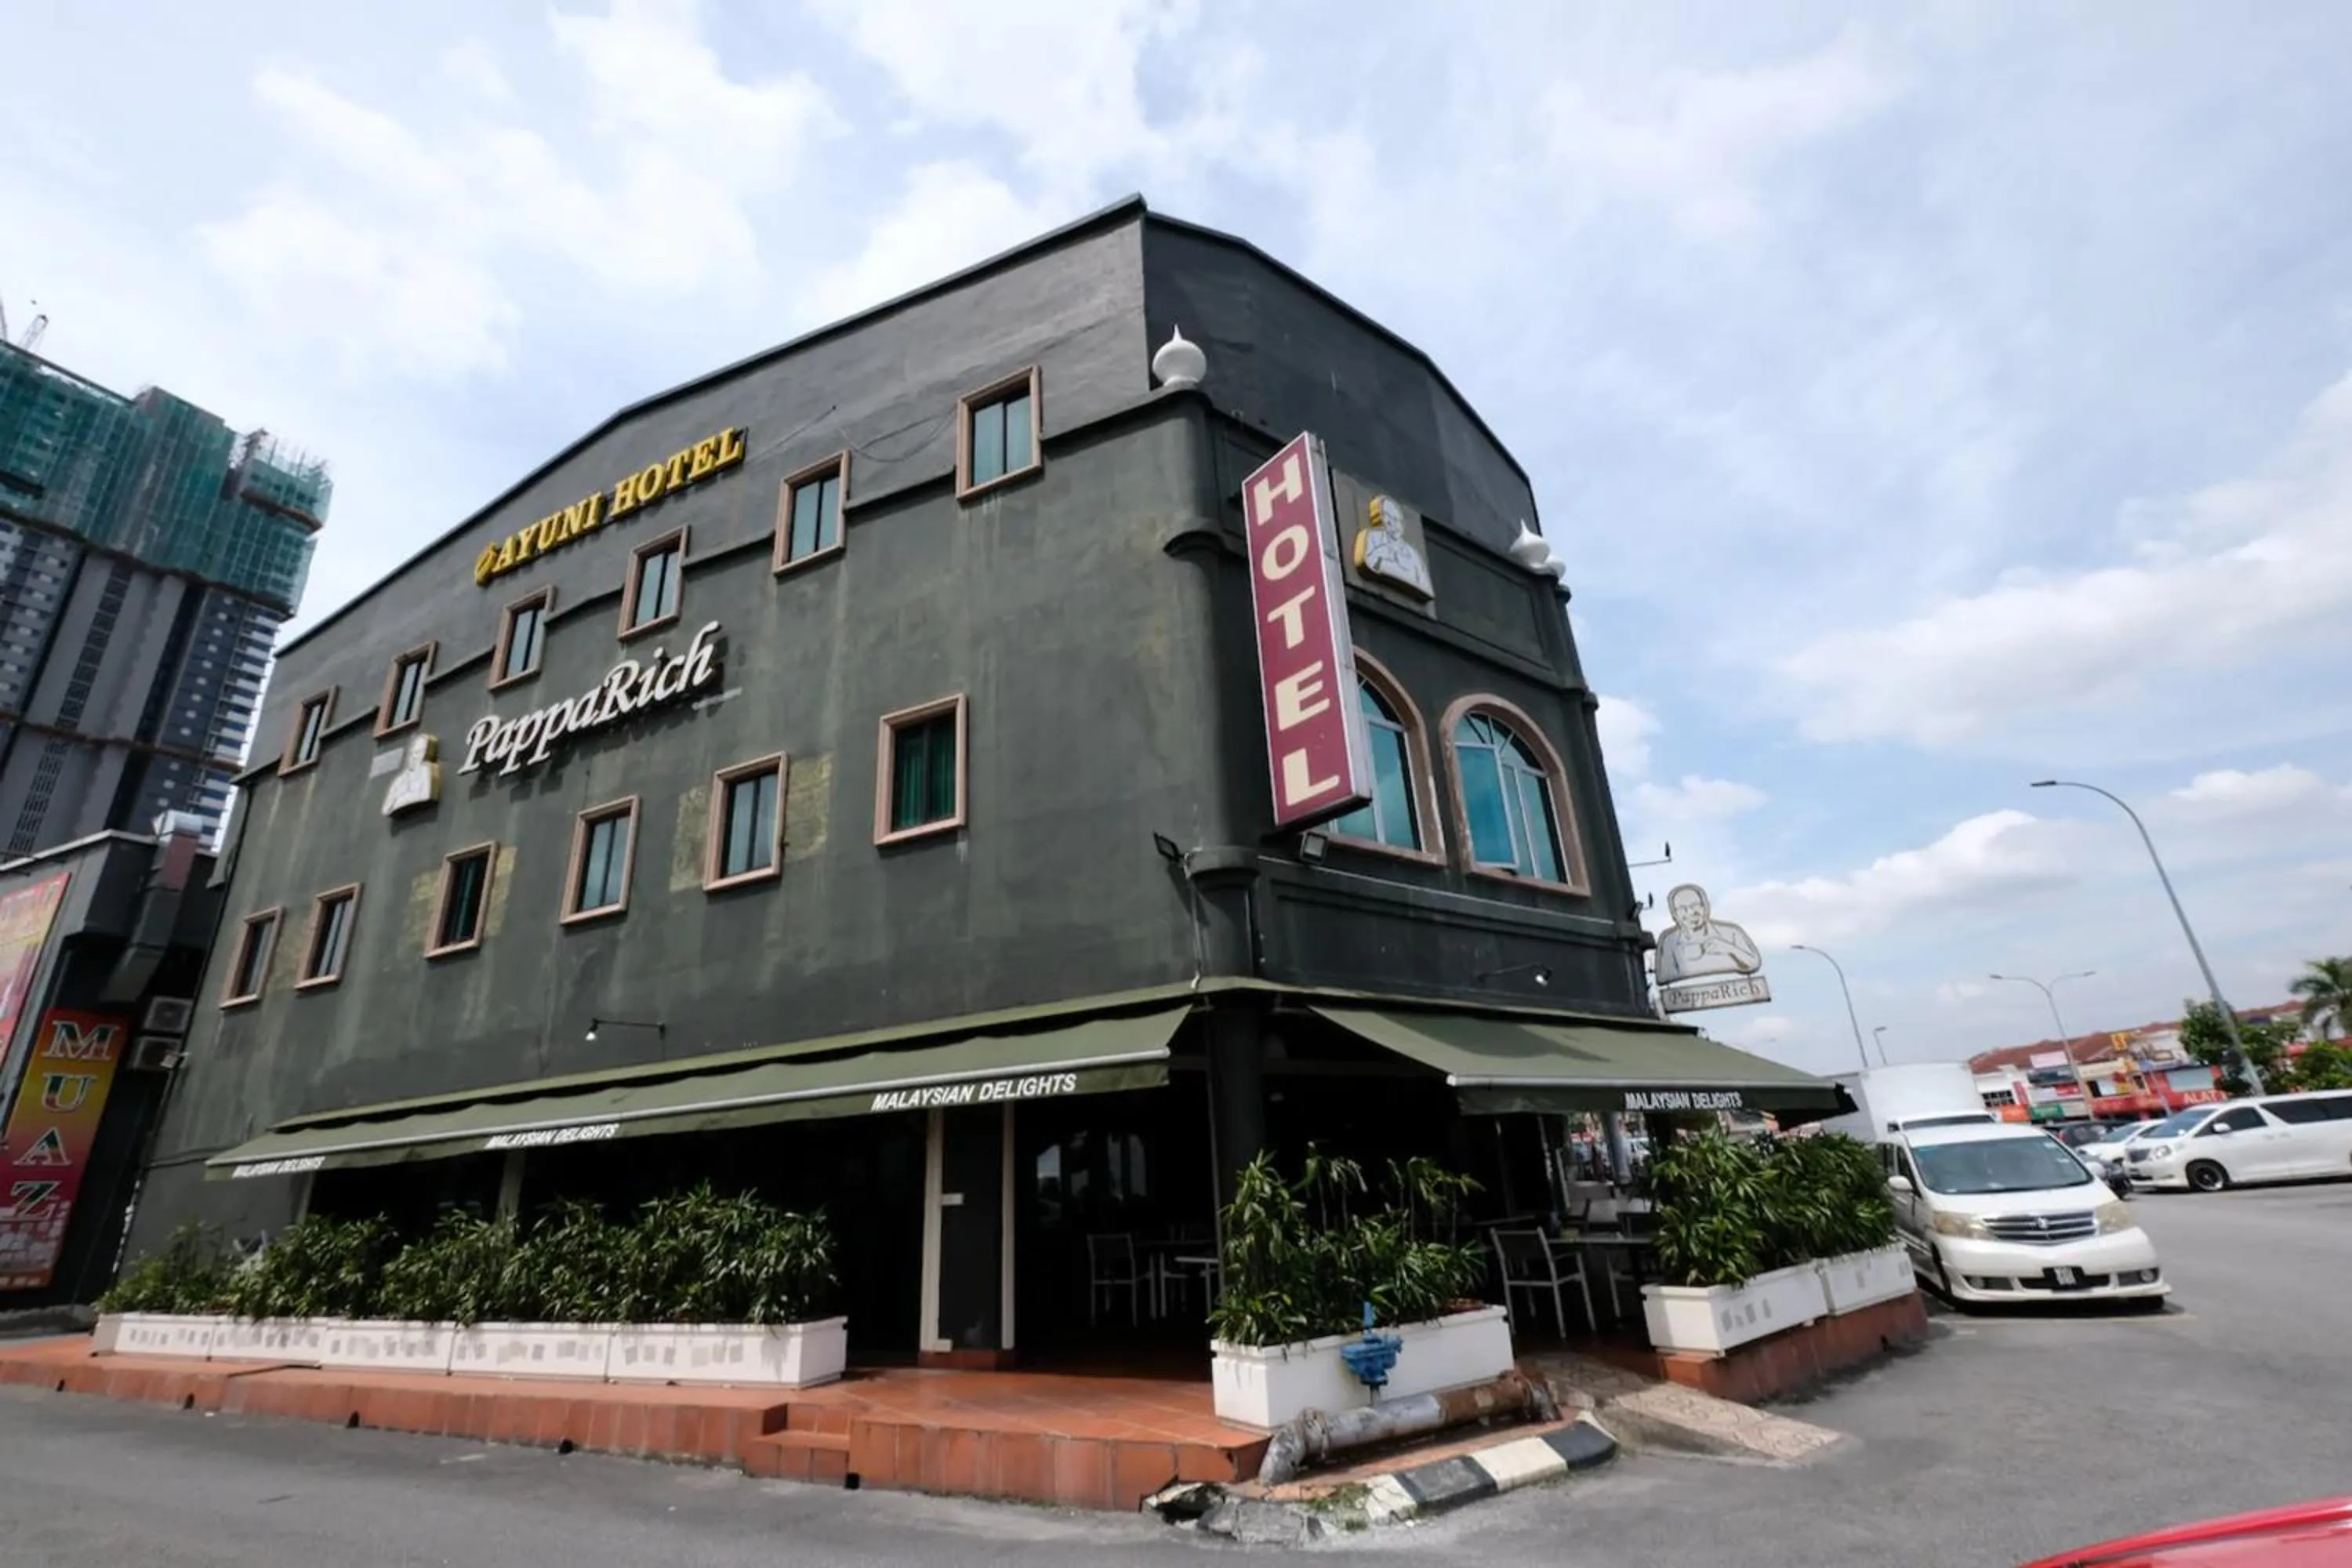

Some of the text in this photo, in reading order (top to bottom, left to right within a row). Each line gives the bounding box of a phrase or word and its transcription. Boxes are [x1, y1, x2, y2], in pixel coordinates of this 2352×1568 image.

[492, 426, 745, 574] AYUNI HOTEL
[456, 620, 723, 778] PappaRich
[1253, 452, 1341, 808] HOTEL
[1668, 982, 1761, 1008] PappaRich
[9, 1019, 120, 1222] MUAZ
[871, 1073, 1077, 1112] MALAYSIAN DELIGHTS
[1624, 1091, 1743, 1110] MALAYSIAN DELIGHTS
